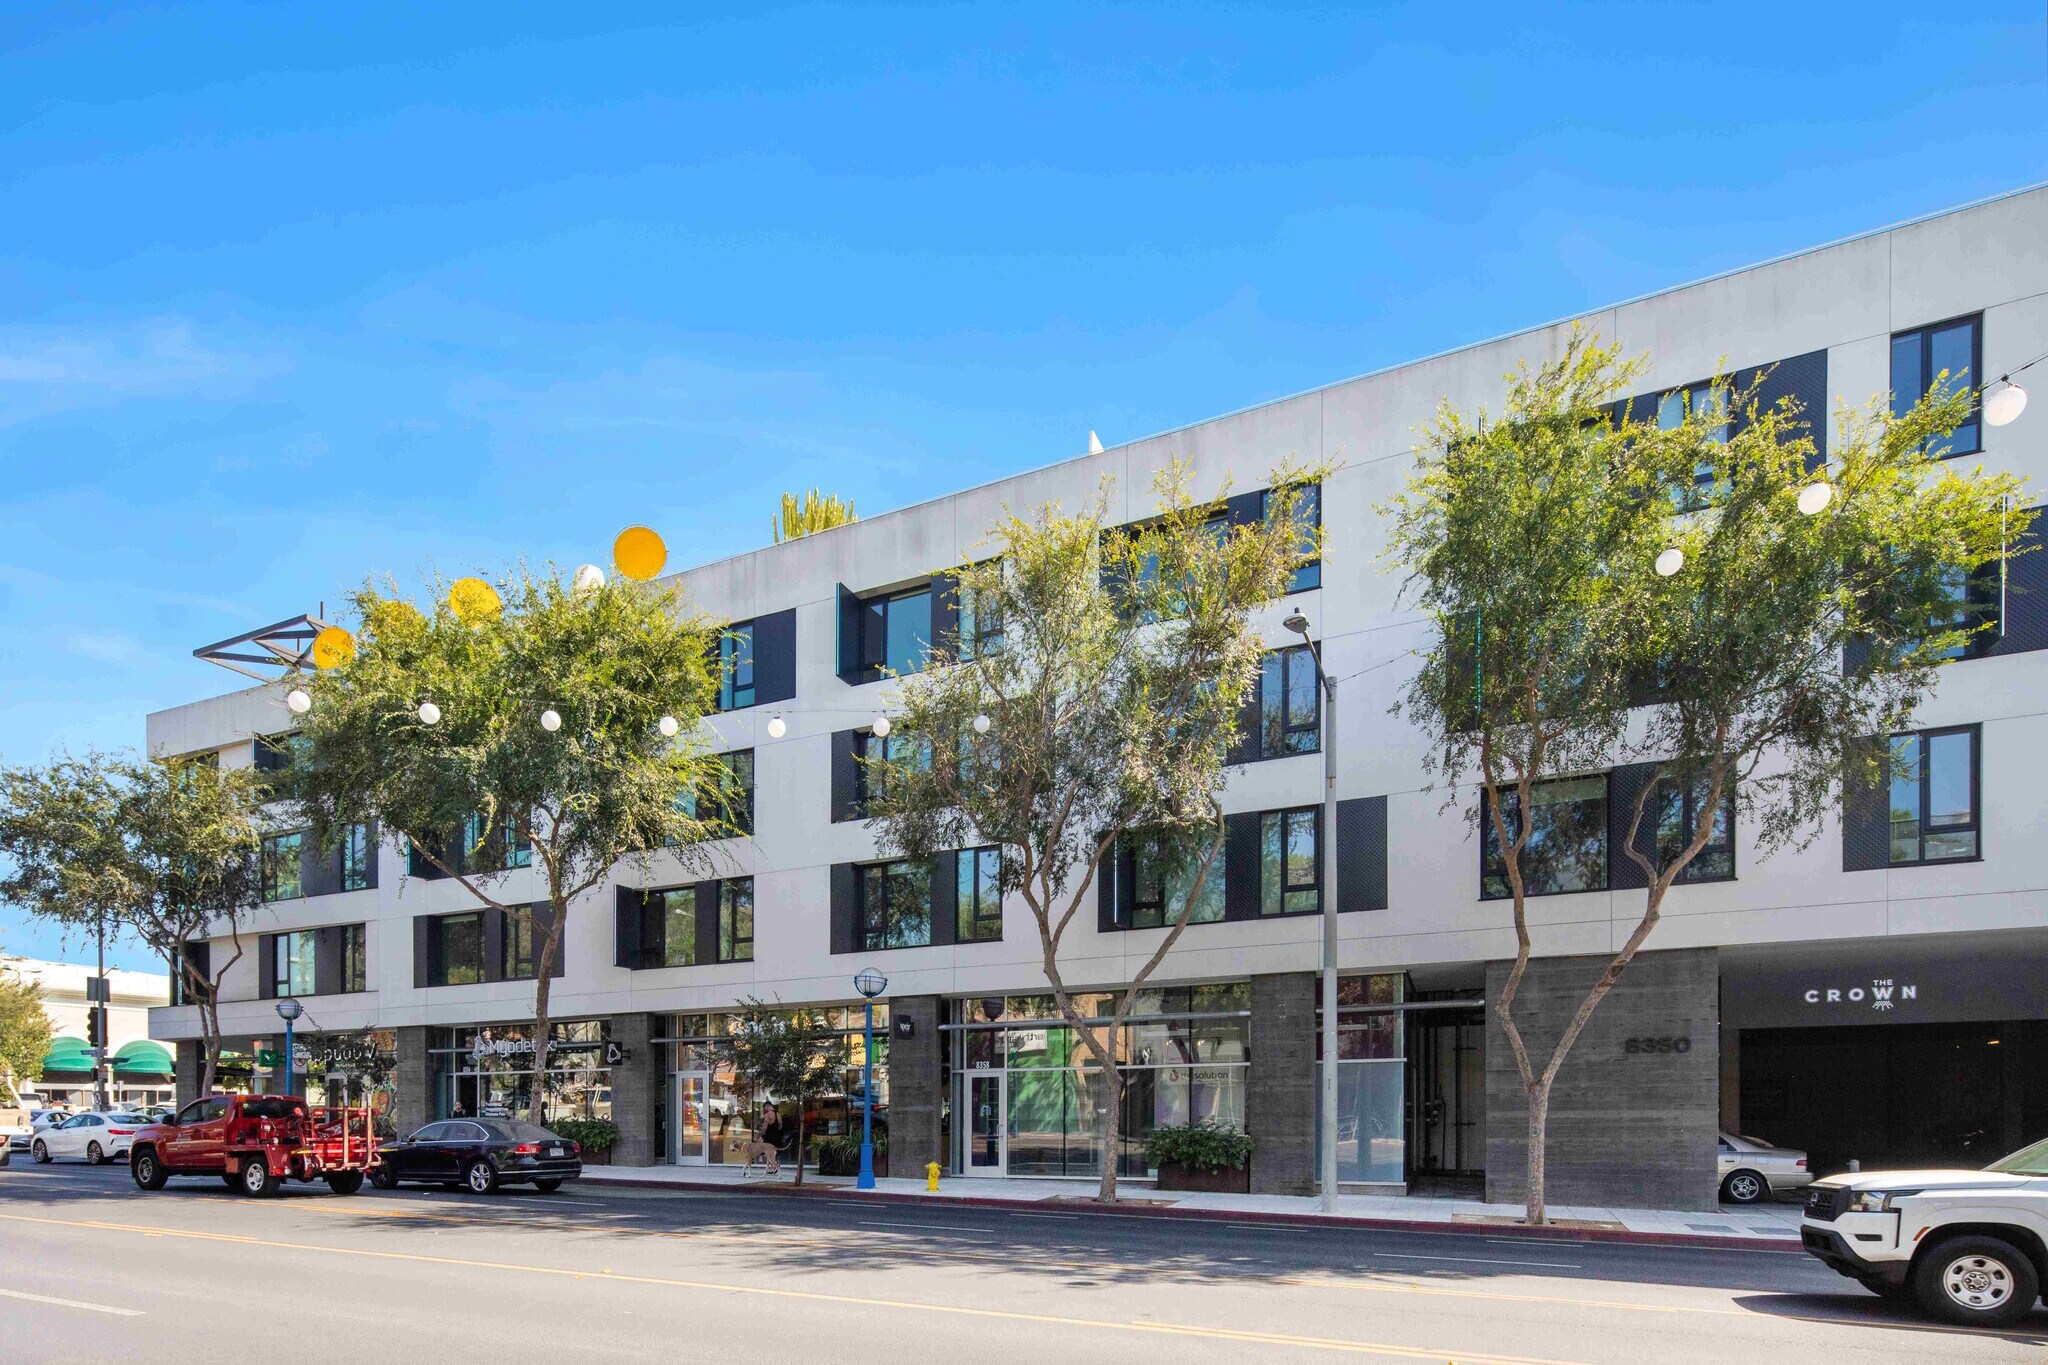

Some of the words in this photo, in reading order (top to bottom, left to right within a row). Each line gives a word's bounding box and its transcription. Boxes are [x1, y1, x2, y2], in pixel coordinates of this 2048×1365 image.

[1804, 984, 1917, 1004] CROWN
[489, 1038, 554, 1057] Myodetx
[1625, 1037, 1691, 1053] 8350
[975, 1060, 990, 1069] 8358
